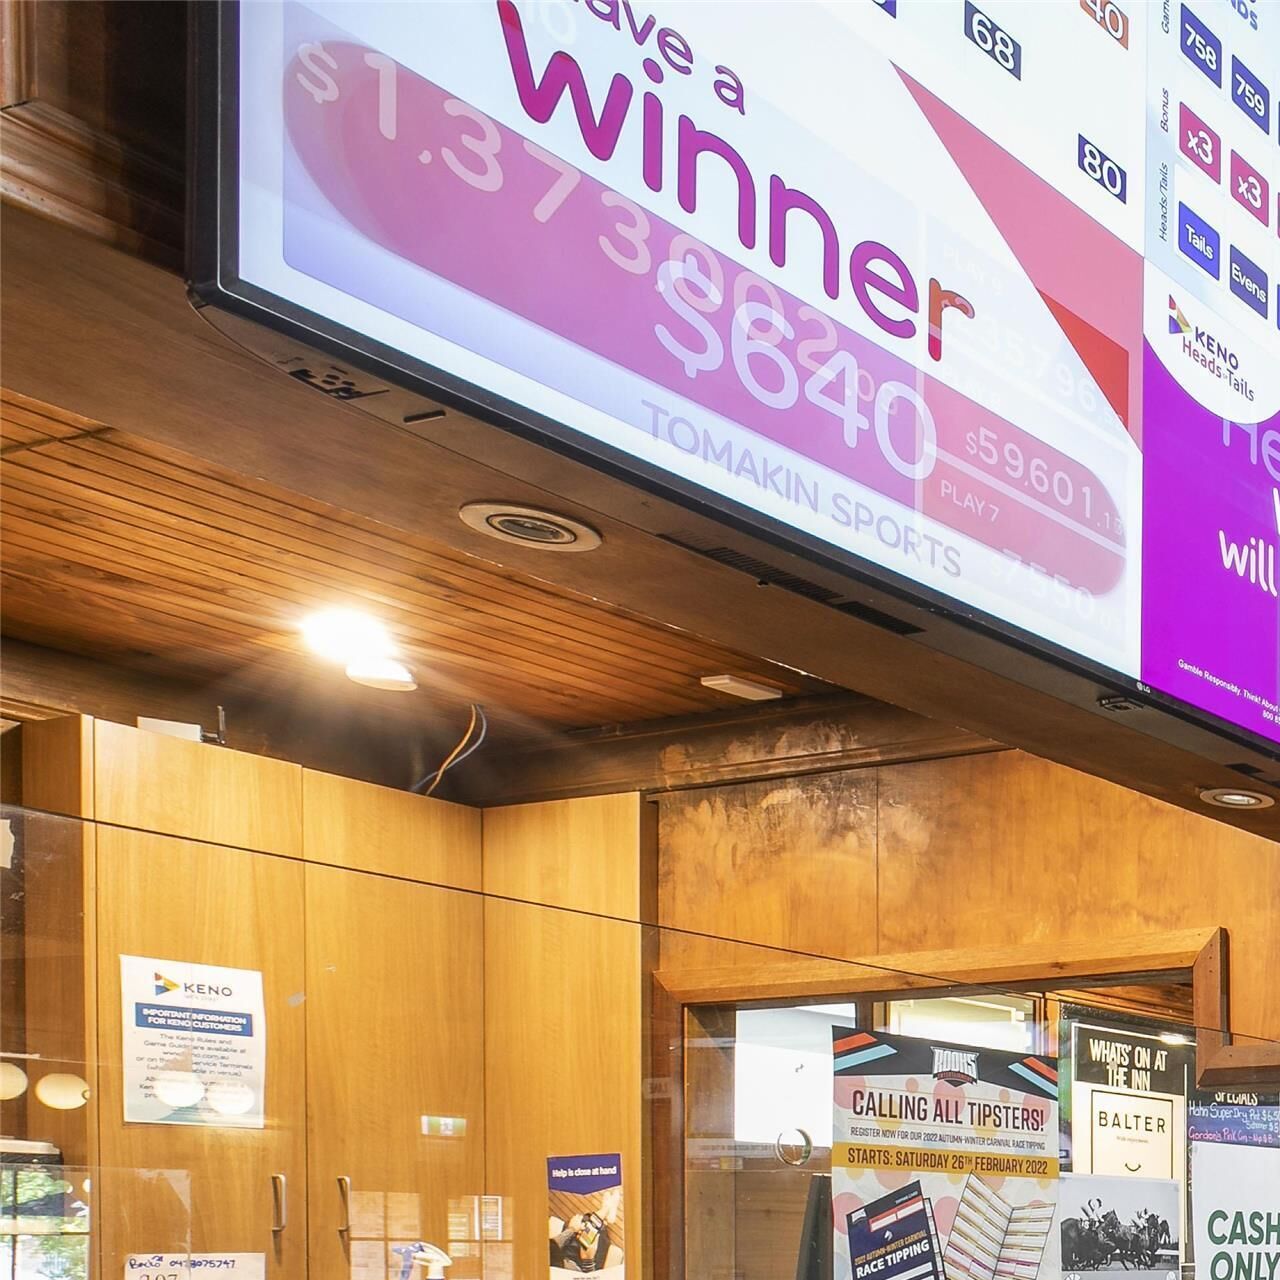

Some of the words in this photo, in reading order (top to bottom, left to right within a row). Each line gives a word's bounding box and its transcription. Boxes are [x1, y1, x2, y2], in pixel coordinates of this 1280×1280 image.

[972, 13, 1018, 69] 68
[1184, 23, 1217, 72] 758
[1082, 143, 1124, 195] 80
[1187, 129, 1214, 166] x3
[497, 0, 975, 362] winner
[1184, 223, 1214, 261] Tails
[1231, 263, 1266, 305] Evens
[655, 256, 938, 482] $640
[1181, 335, 1222, 380] Heads
[1226, 369, 1255, 402] Tails
[1194, 329, 1239, 370] KENO
[641, 399, 820, 513] TOMAKIN
[831, 492, 963, 579] SPORTS
[1218, 529, 1278, 598] will
[183, 982, 233, 997] KENO
[1106, 1065, 1129, 1089] THE
[1131, 1068, 1150, 1091] INN
[1135, 1046, 1151, 1070] ON
[1154, 1050, 1169, 1072] AT
[852, 1089, 928, 1121] CALLING
[932, 1098, 963, 1124] ALL
[967, 1102, 1044, 1132] TIPSTERS!
[1098, 1110, 1167, 1135] BALTER
[847, 1147, 893, 1166] STARTS:
[895, 1150, 949, 1170] SATURDAY
[951, 1154, 973, 1171] 26TH
[974, 1156, 1023, 1173] FEBRUARY
[1025, 1160, 1049, 1175] 2022
[856, 1257, 886, 1280] RACE
[886, 1239, 930, 1268] TIPPING
